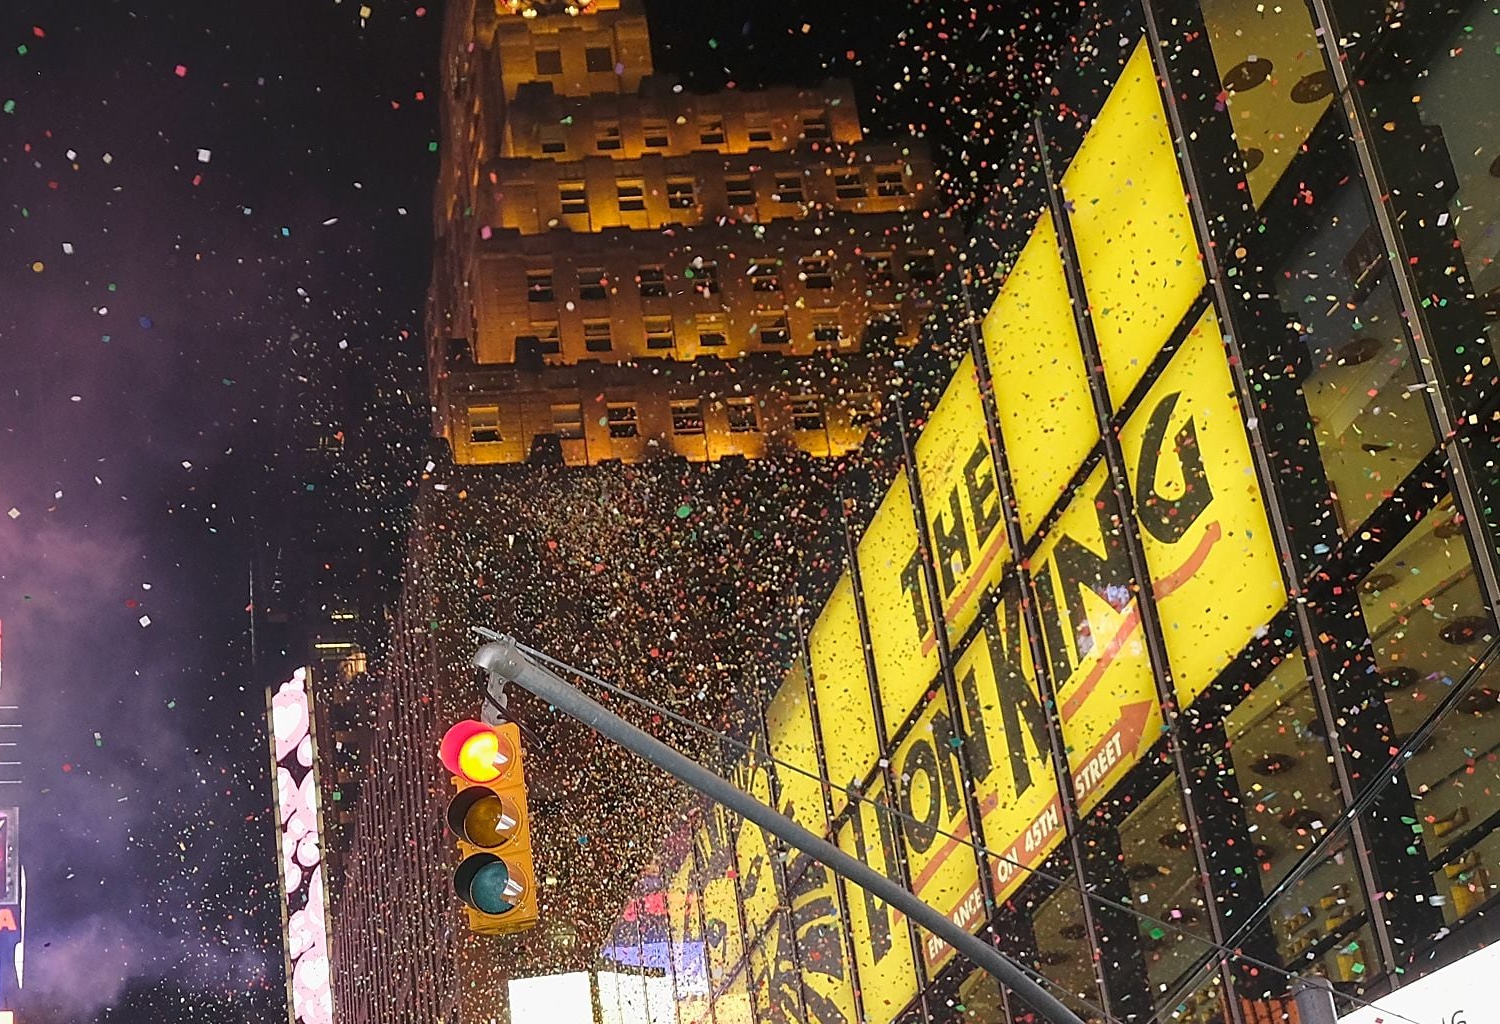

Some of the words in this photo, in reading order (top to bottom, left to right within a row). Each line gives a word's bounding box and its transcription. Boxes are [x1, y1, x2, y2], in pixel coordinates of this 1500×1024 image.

[900, 437, 1002, 643] THE
[845, 666, 994, 967] LION
[984, 391, 1216, 802] KING
[928, 886, 982, 961] ENANCE
[997, 846, 1018, 883] ON
[1024, 803, 1060, 854] 45TH
[1075, 731, 1123, 801] STREET
